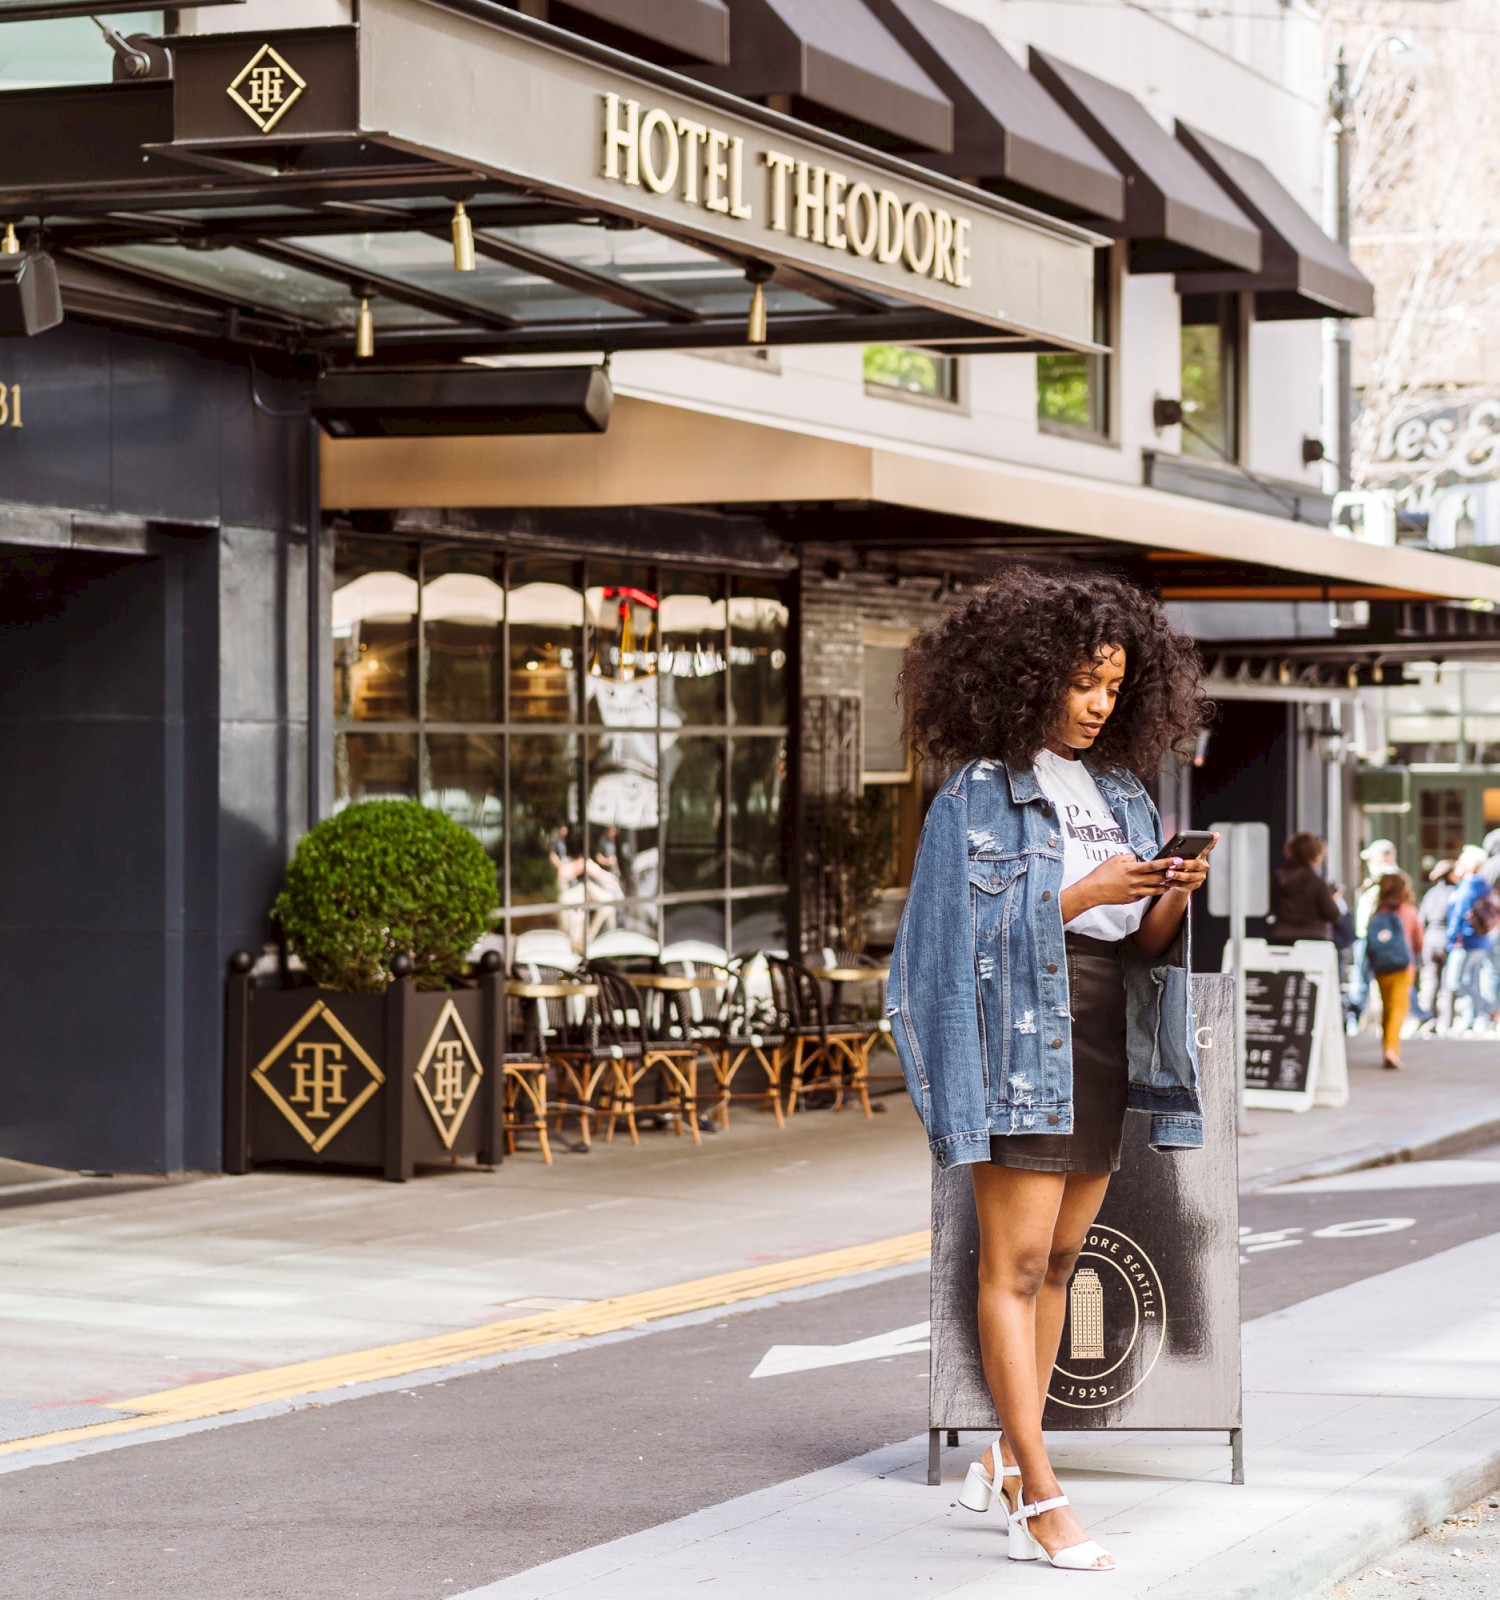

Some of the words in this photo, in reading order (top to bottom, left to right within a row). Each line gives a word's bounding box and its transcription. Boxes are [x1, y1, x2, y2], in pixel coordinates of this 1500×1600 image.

[605, 91, 752, 221] HOTEL
[765, 150, 973, 288] THEODORE
[1123, 1253, 1155, 1318] SEATTLE
